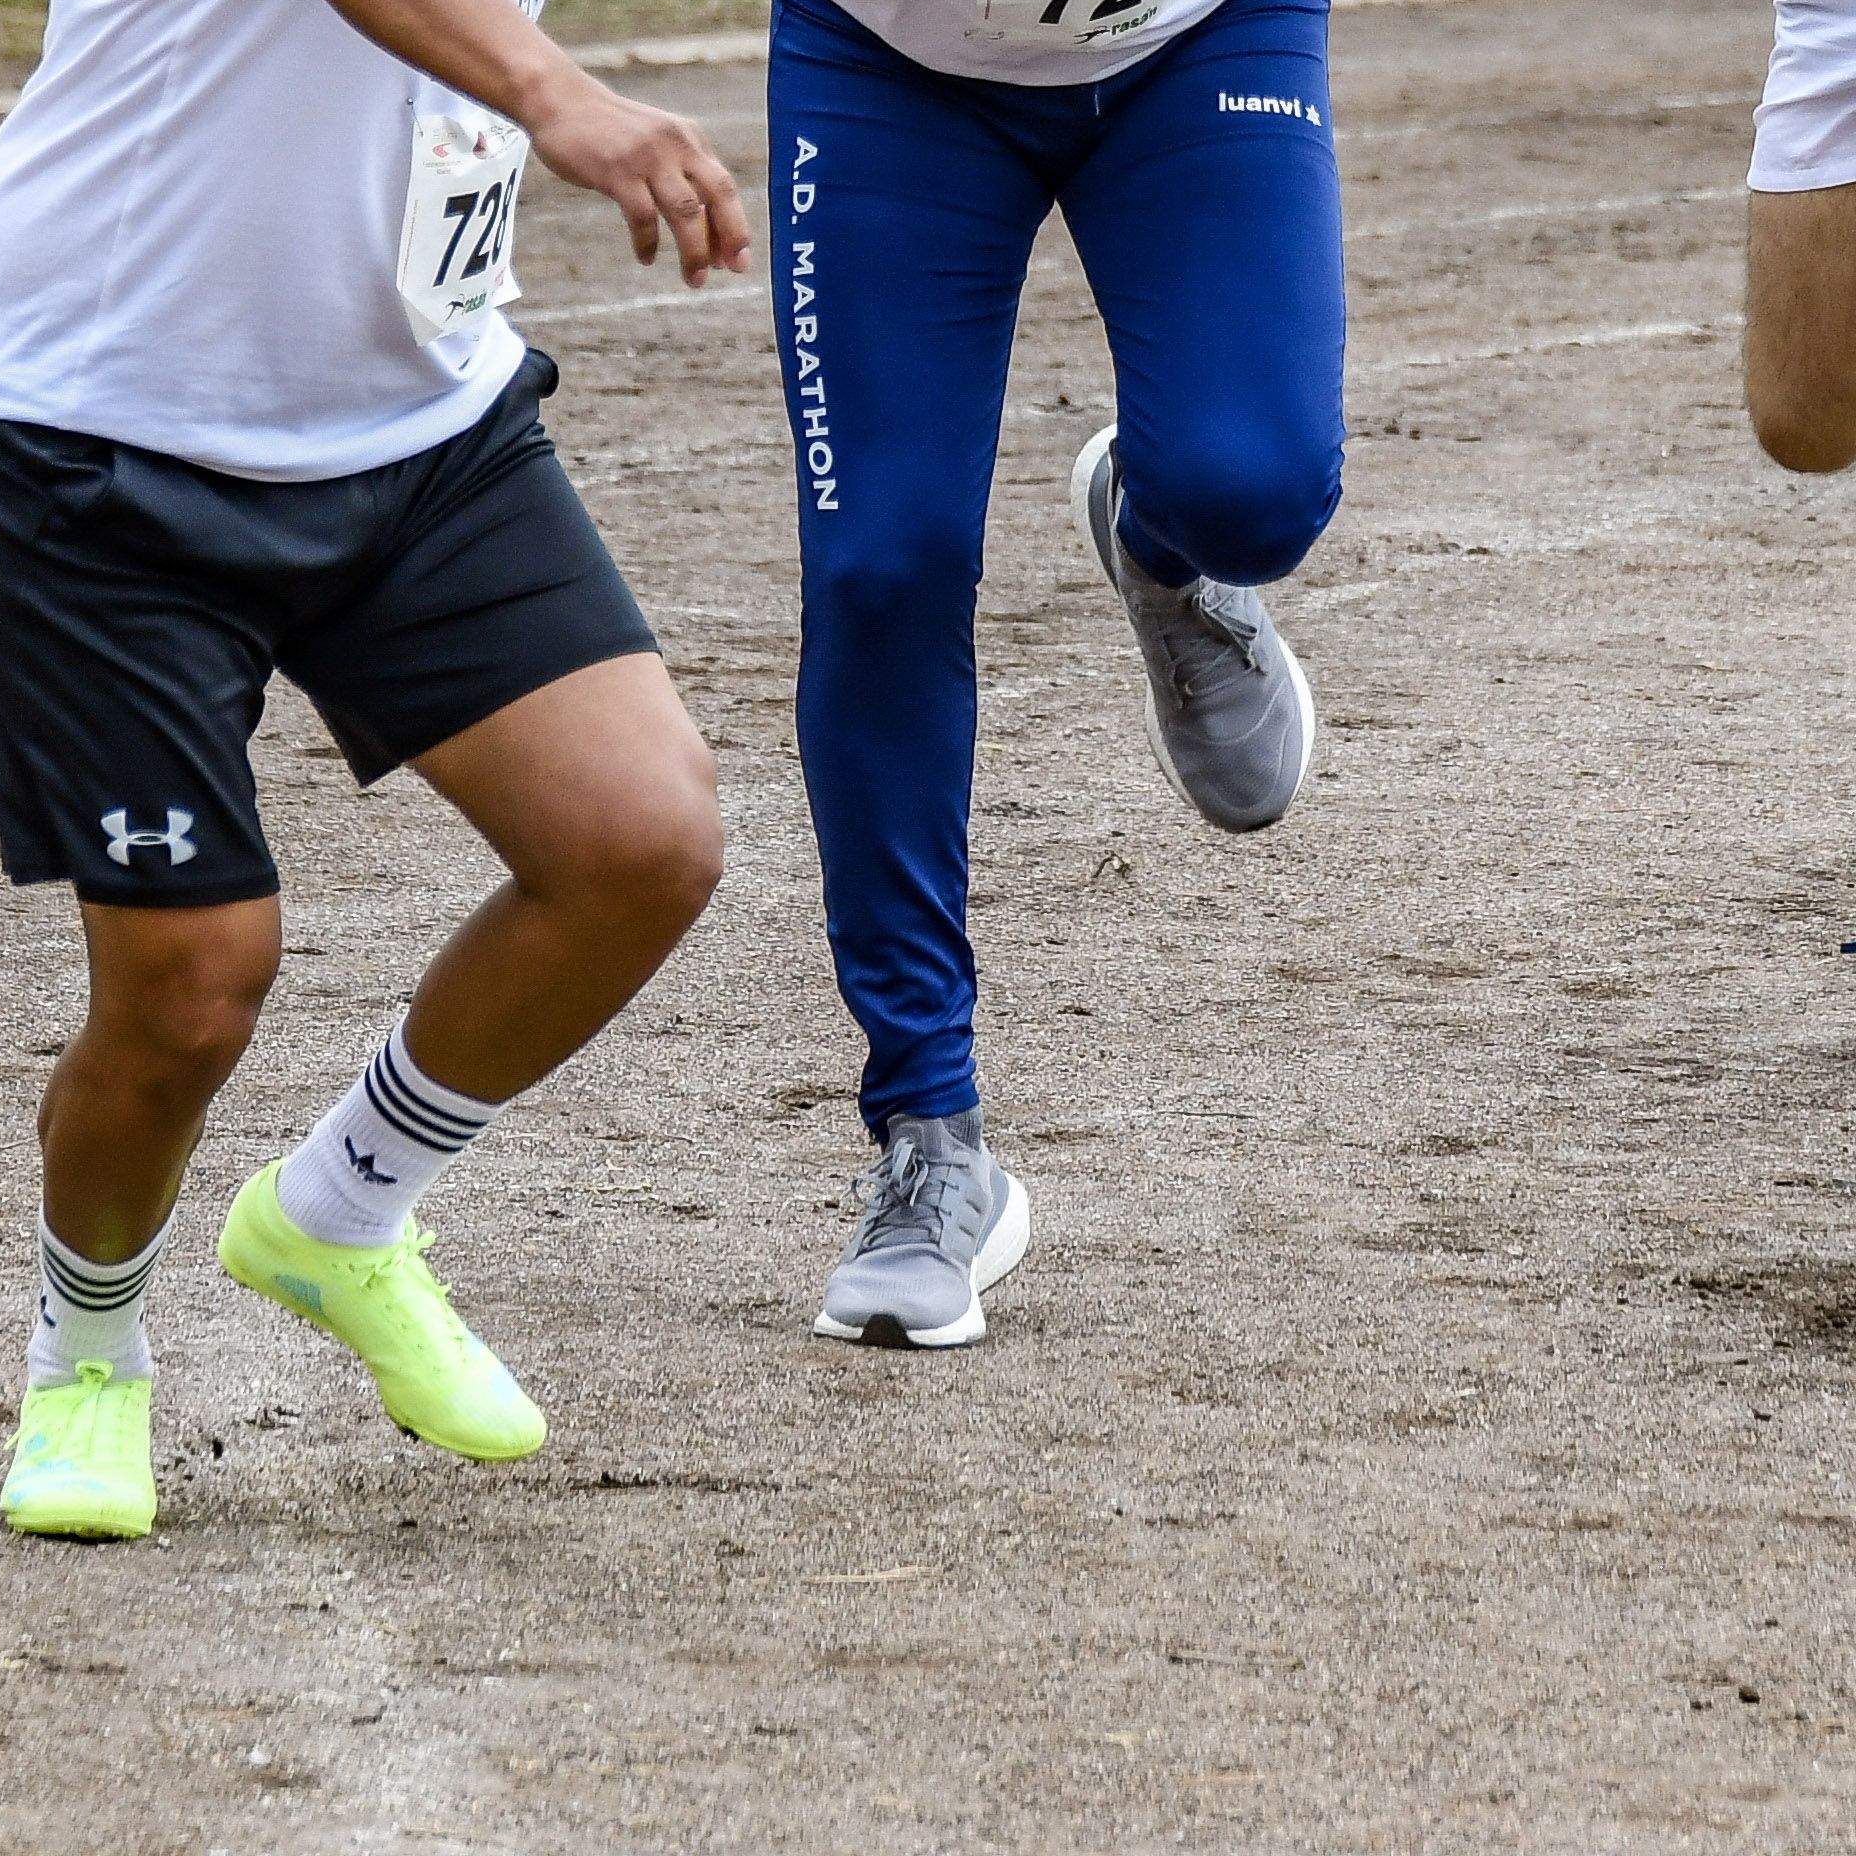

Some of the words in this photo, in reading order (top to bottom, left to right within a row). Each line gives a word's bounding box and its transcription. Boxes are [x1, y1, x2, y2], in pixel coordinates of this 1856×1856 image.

[1218, 92, 1302, 118] luanvi
[432, 167, 518, 287] 728
[791, 135, 819, 225] A.D.
[791, 240, 840, 511] MARATHON
